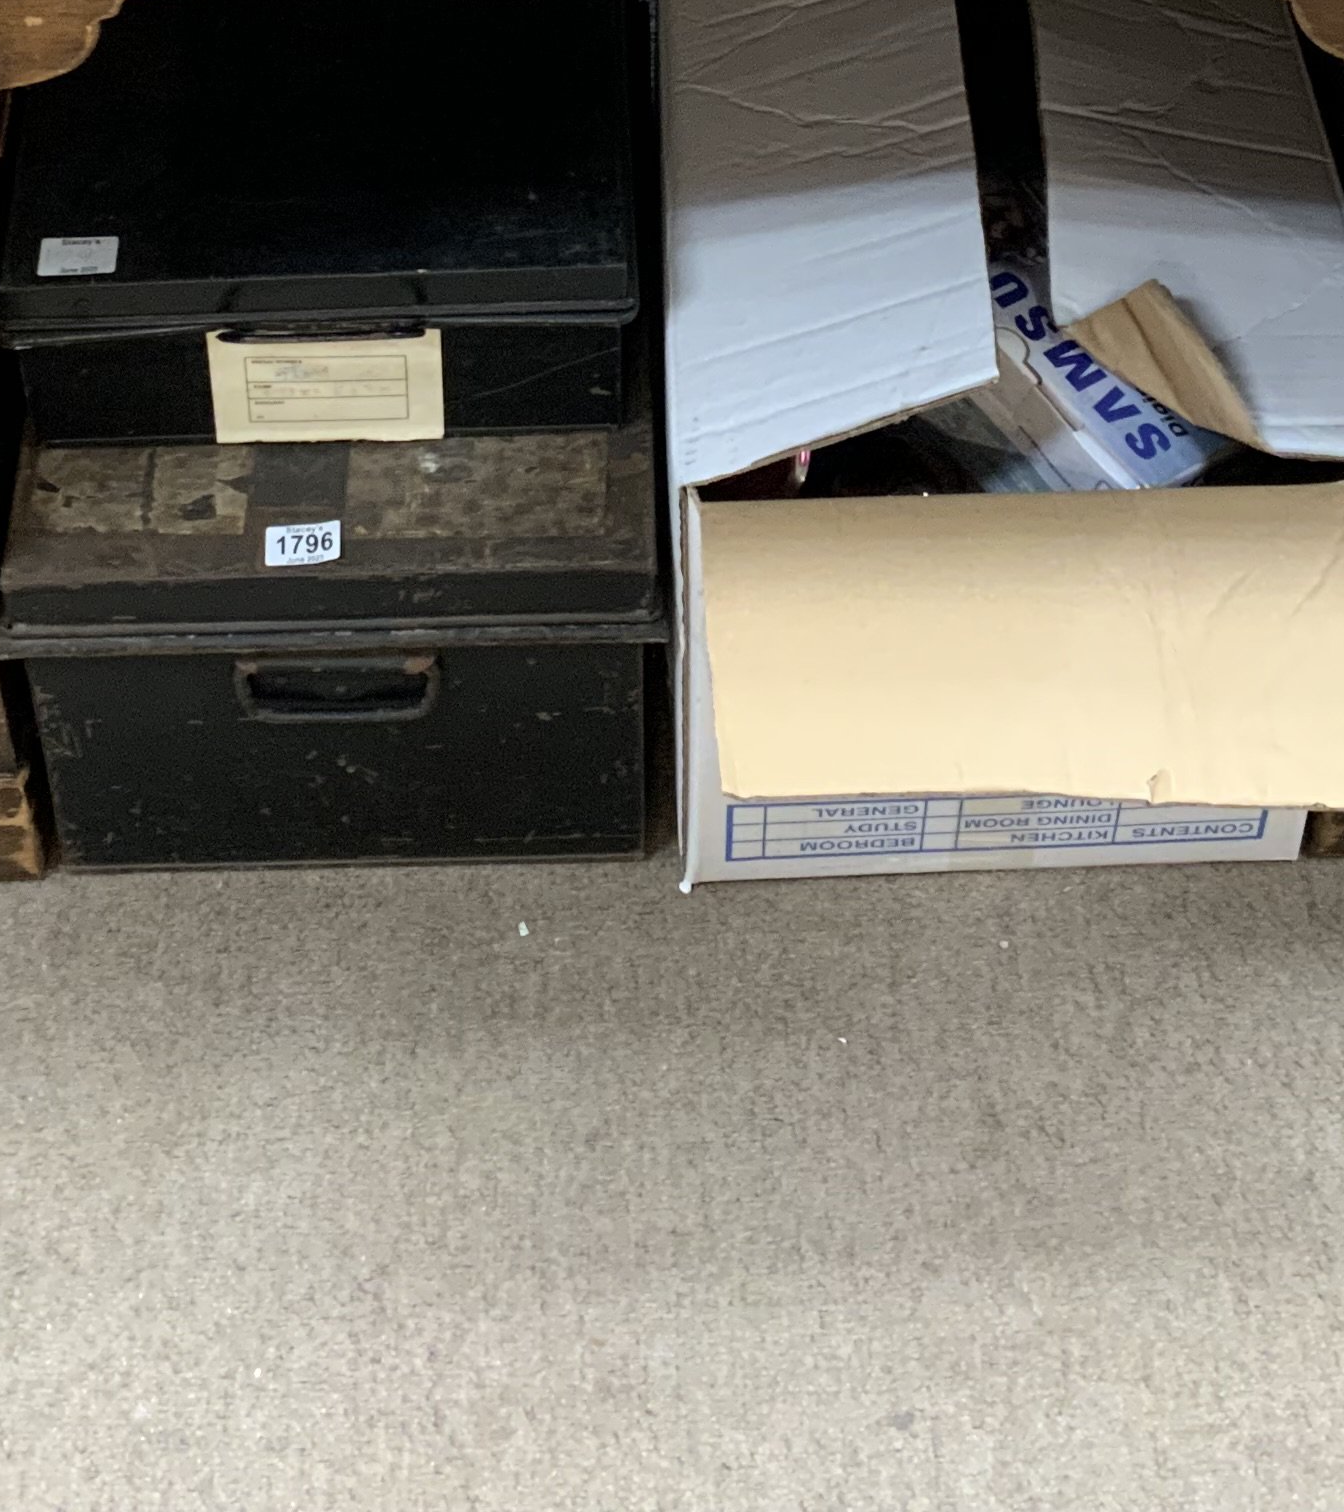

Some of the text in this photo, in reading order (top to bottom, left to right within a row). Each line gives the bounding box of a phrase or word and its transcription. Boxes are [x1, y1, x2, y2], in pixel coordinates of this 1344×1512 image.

[276, 531, 334, 555] 1796
[812, 803, 920, 818] GENERAL
[1021, 799, 1113, 810] OUNGE
[844, 820, 918, 834] STUDY
[965, 813, 1112, 828] DINING ROOM
[1010, 829, 1109, 843] KITCHEN
[1132, 822, 1254, 838] CONTENTS
[799, 836, 916, 852] BEDROOM
